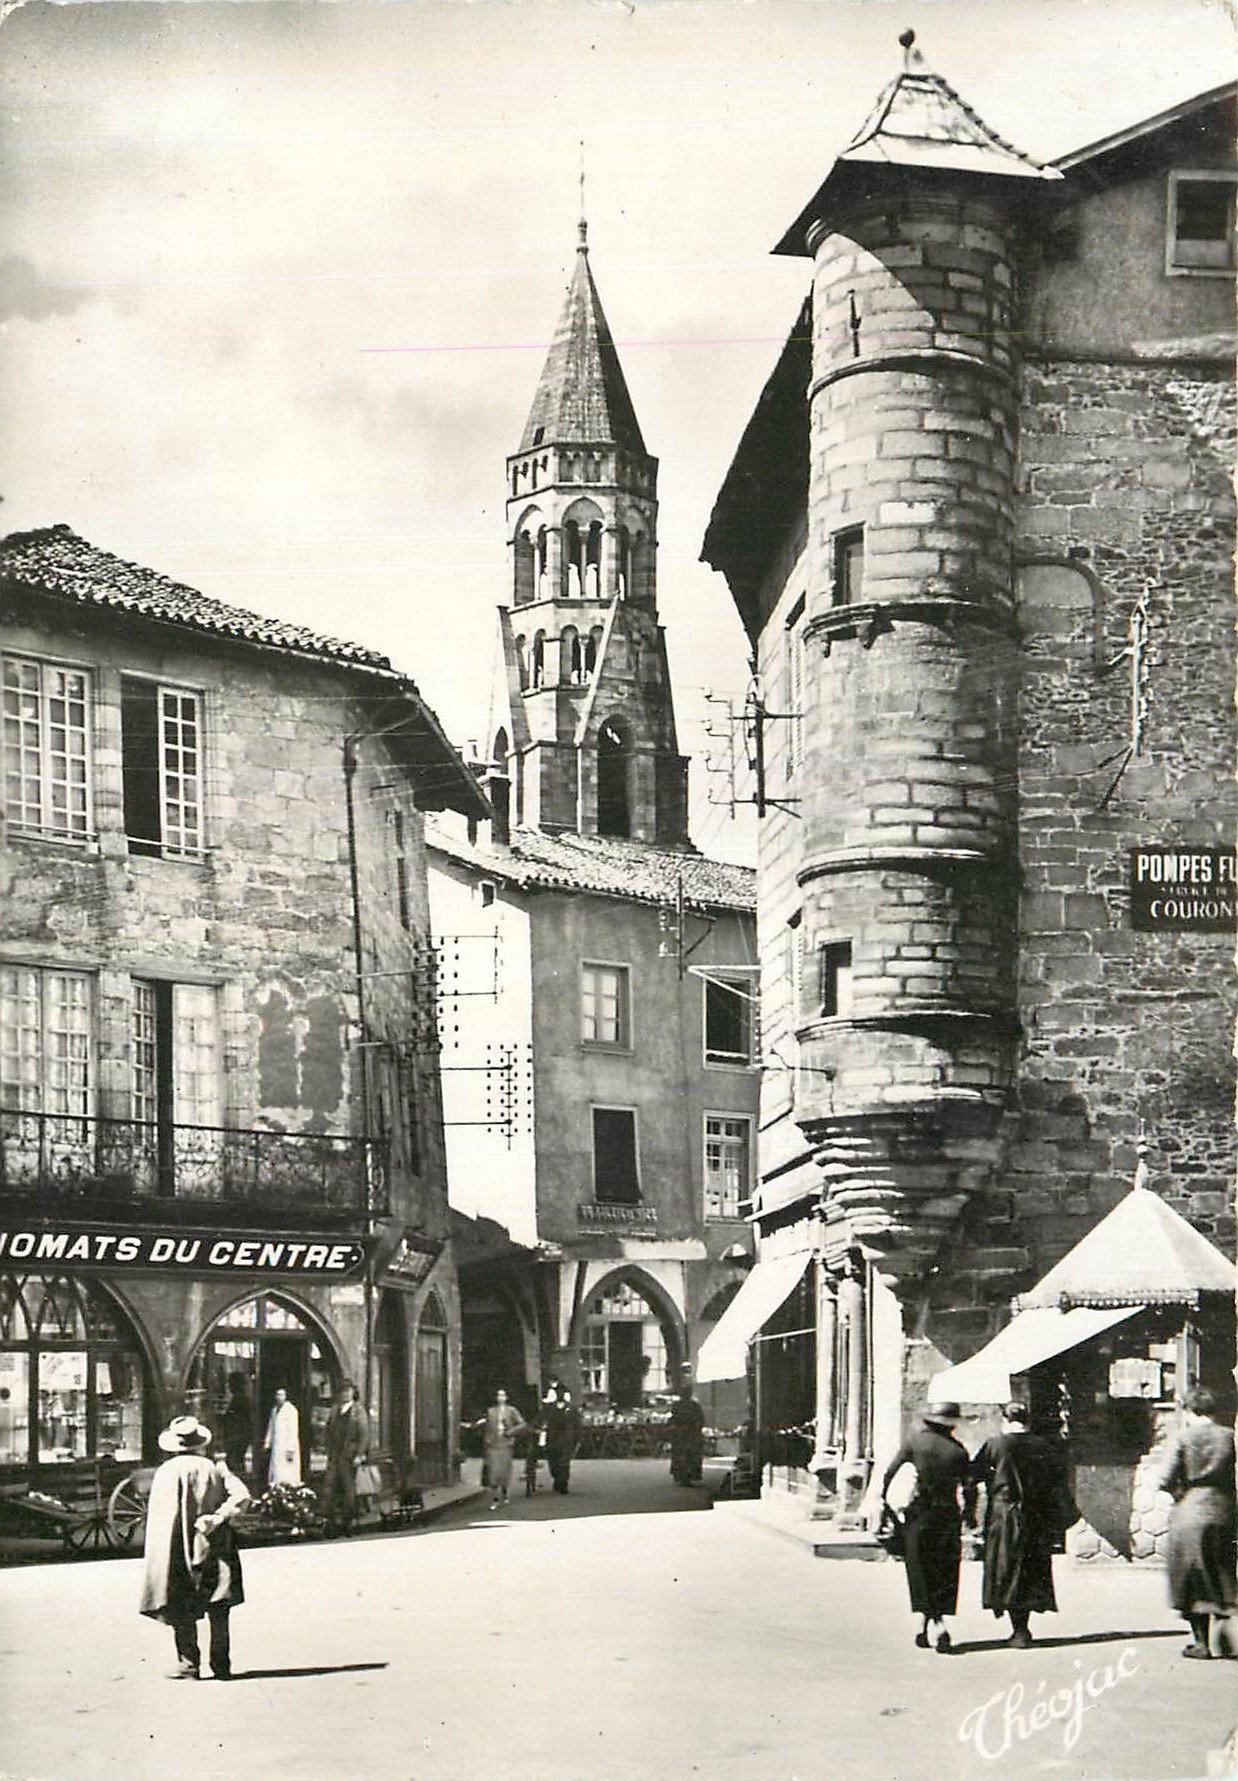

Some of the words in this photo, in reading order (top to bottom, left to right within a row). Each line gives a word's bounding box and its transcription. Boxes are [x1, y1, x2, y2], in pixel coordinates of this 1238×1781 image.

[1137, 854, 1212, 882] POMPES
[149, 1238, 201, 1263] DU
[208, 1241, 352, 1269] CENTRE
